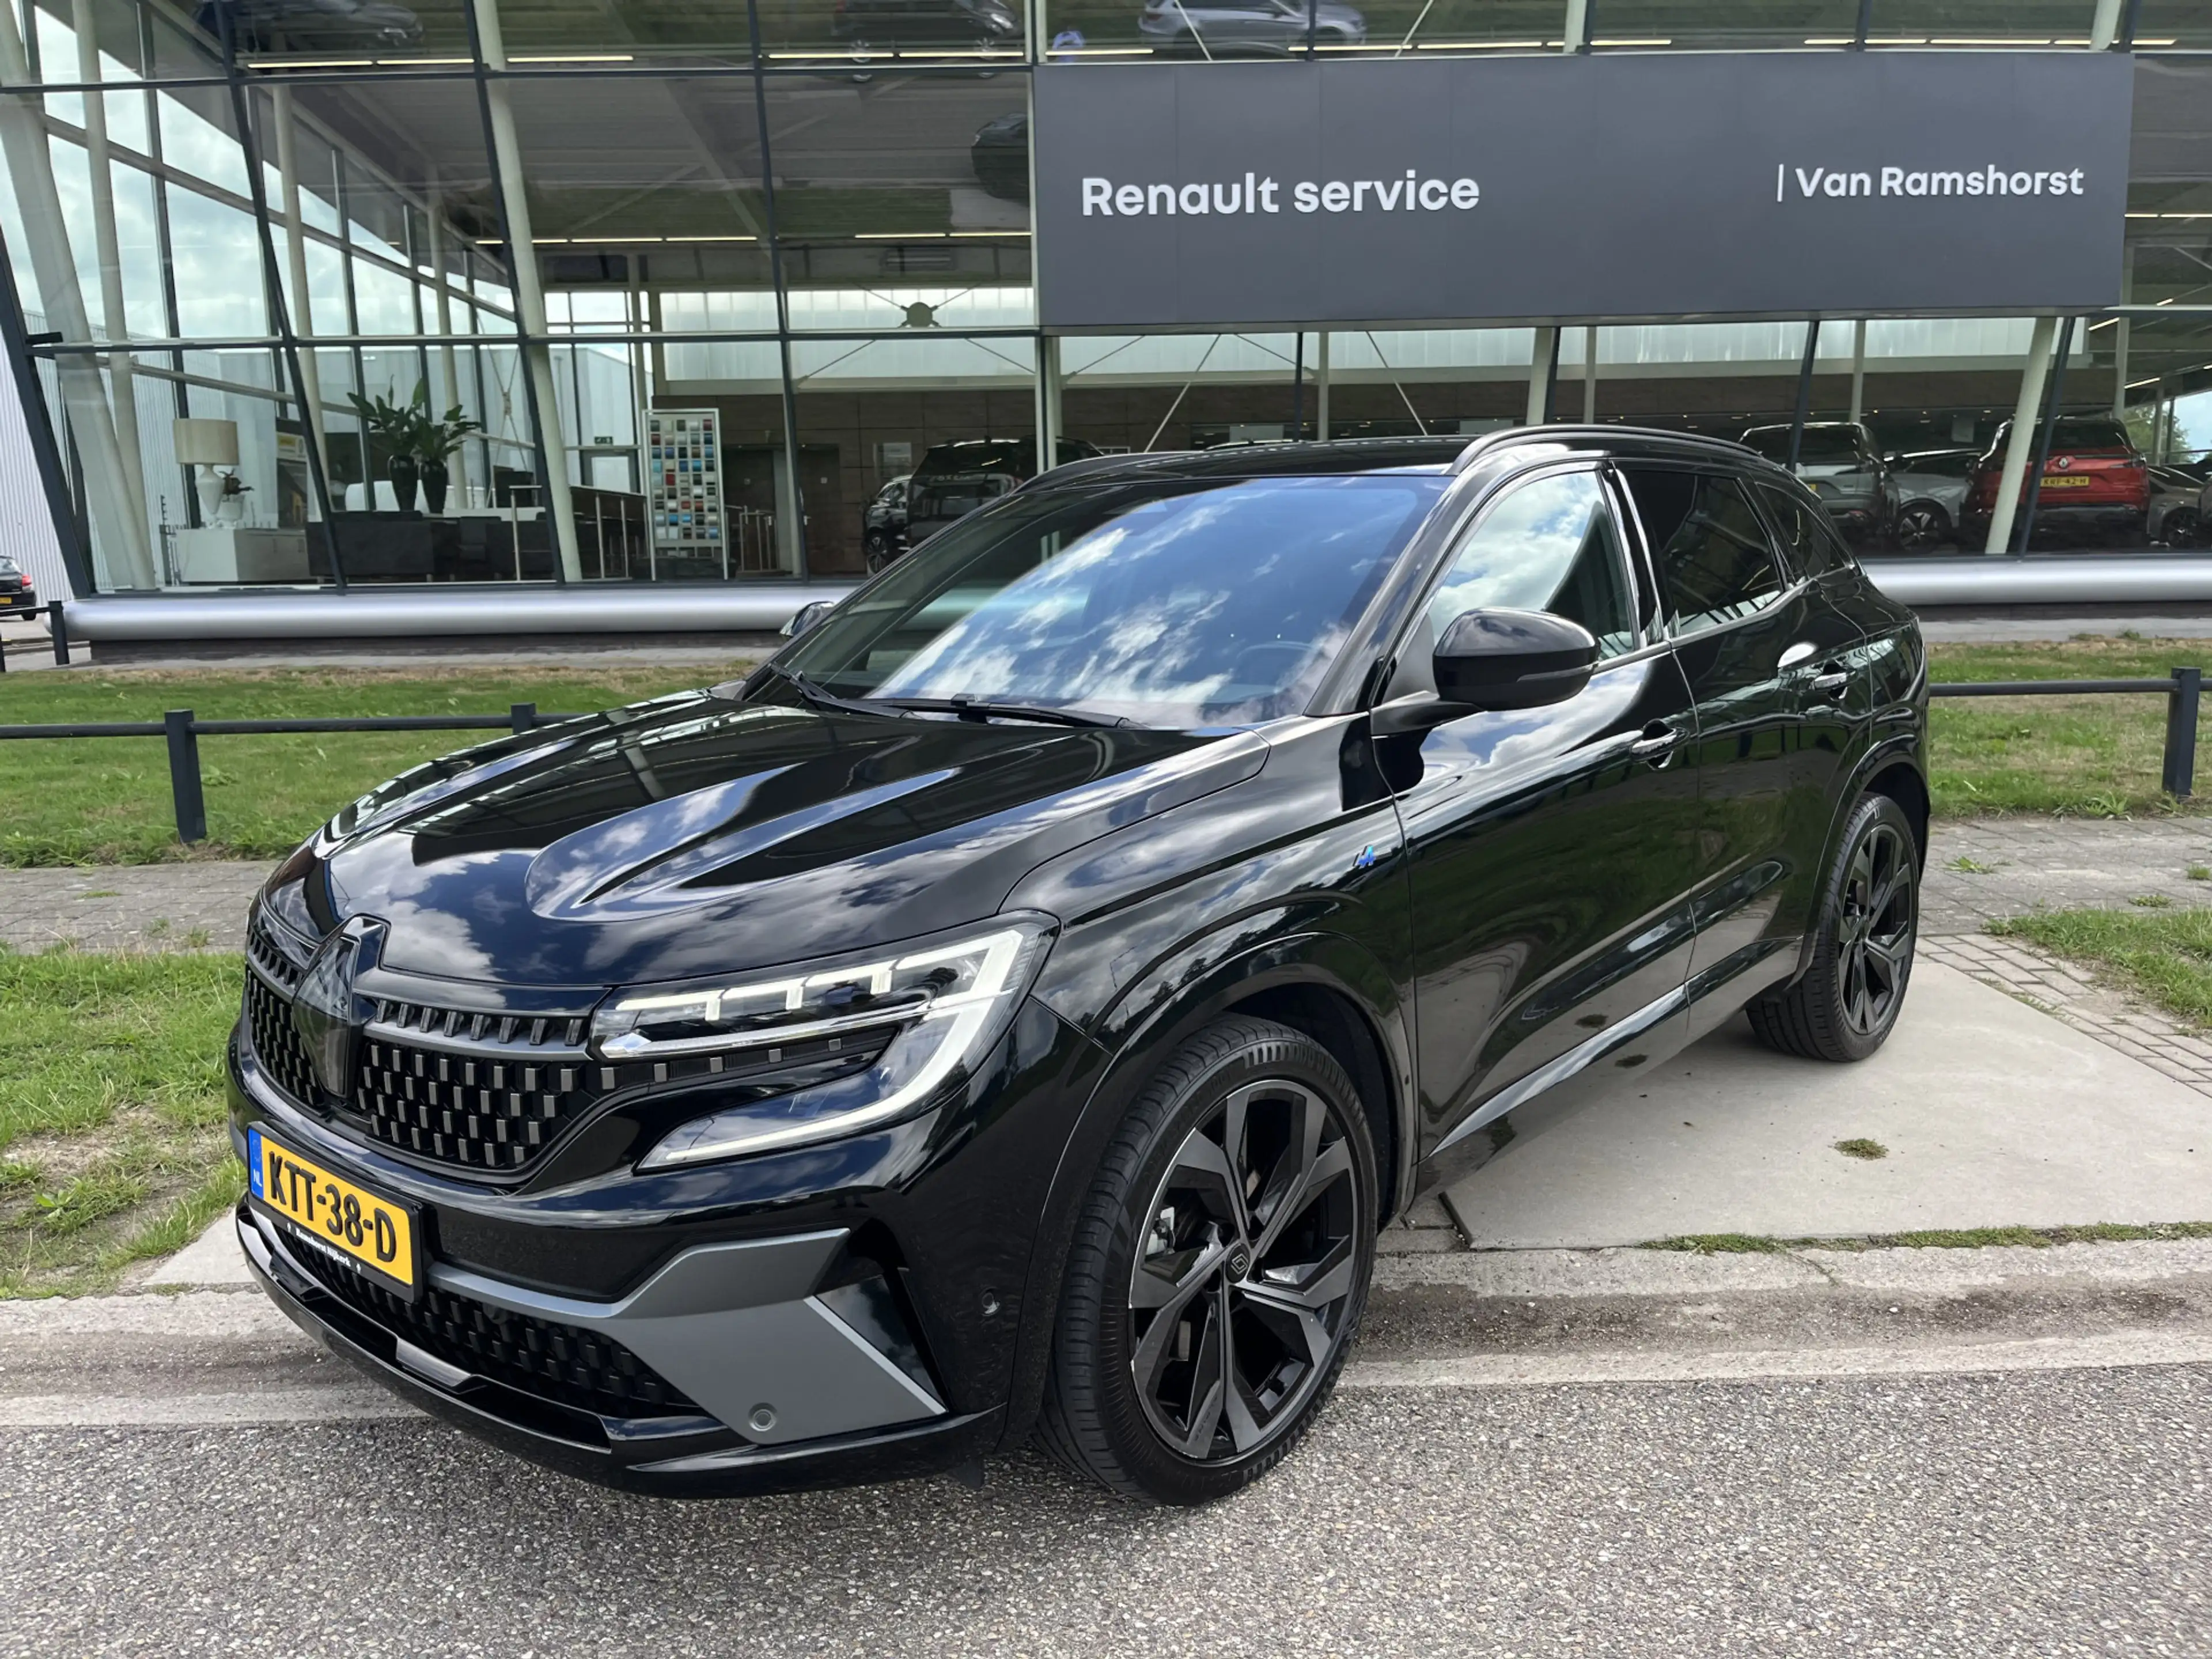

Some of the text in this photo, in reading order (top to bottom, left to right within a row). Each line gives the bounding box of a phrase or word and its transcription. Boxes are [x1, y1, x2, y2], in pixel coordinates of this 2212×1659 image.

[1081, 169, 1480, 216] Renault service
[1795, 164, 2084, 197] Van Ramshorst
[253, 1168, 263, 1187] NL
[268, 1151, 396, 1263] KTT-38-D
